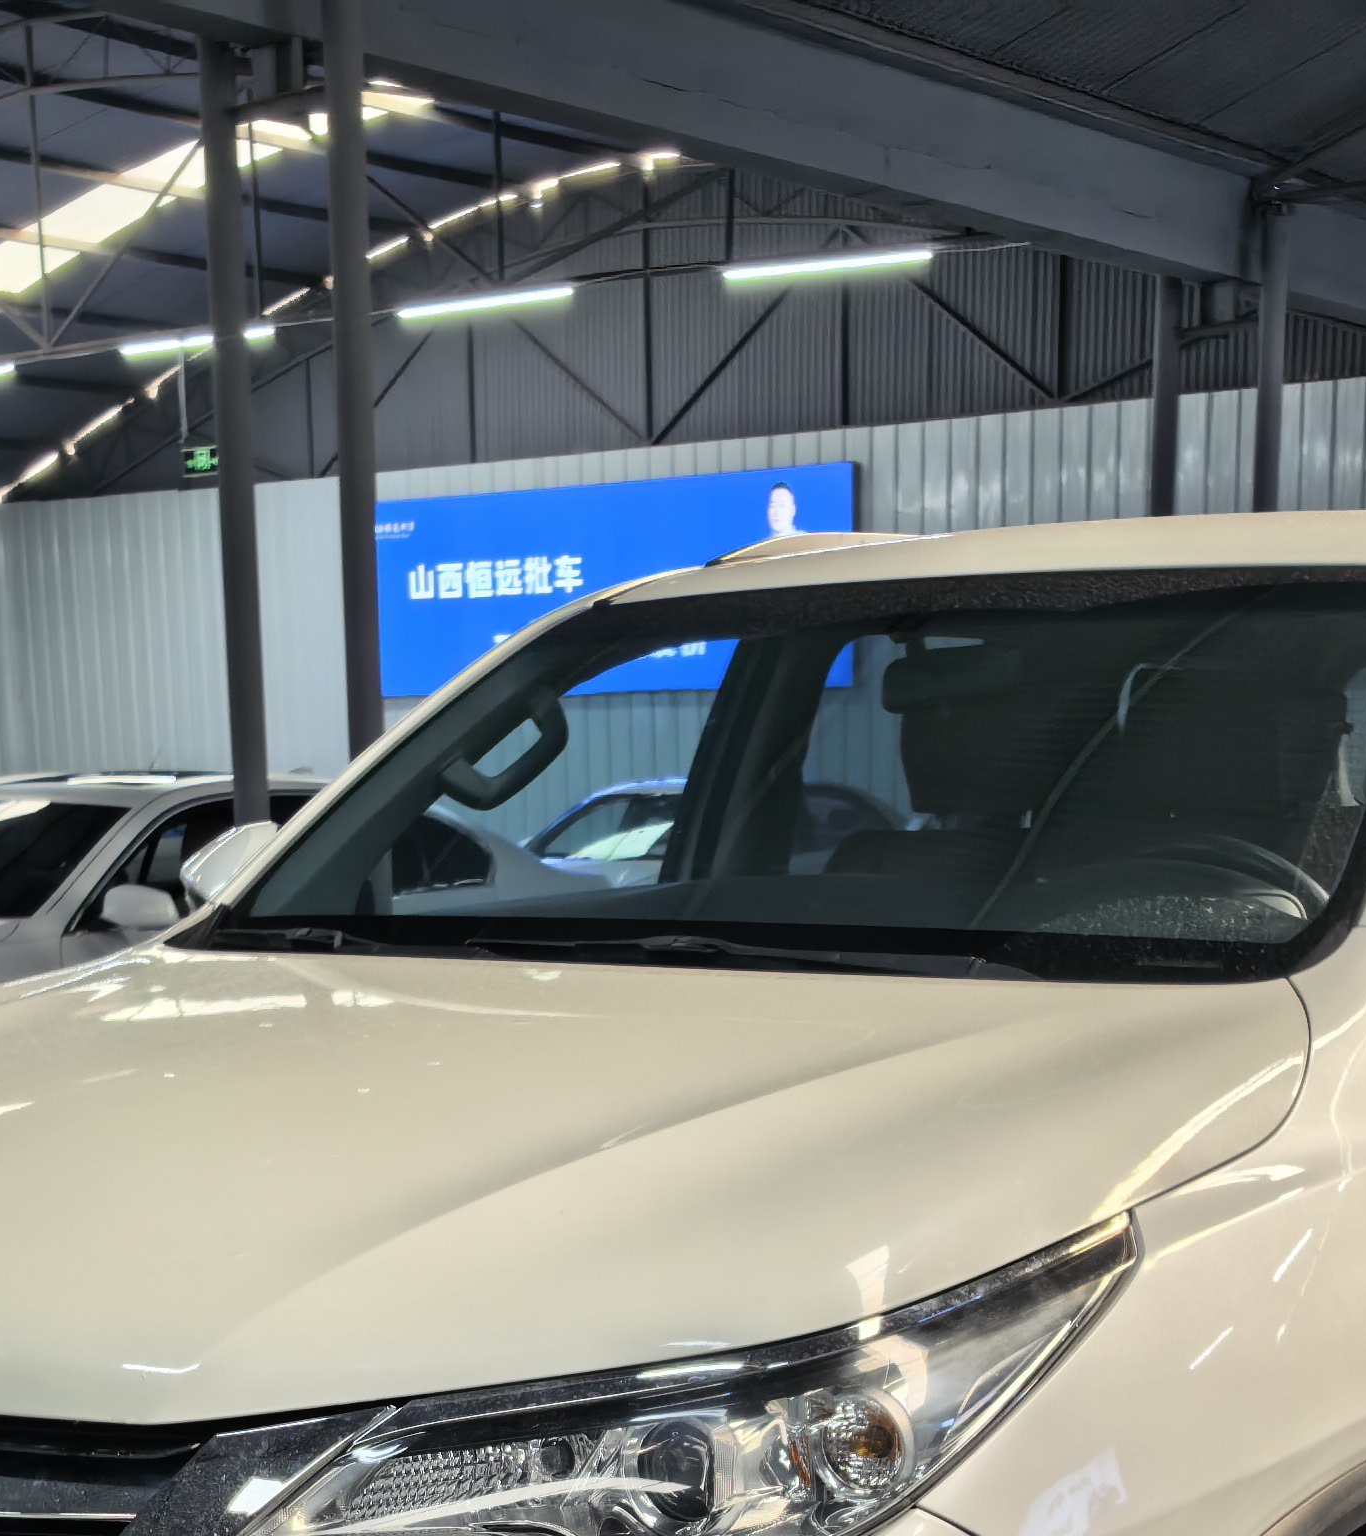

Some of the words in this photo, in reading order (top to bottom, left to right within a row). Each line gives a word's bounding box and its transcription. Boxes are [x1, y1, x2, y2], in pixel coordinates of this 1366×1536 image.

[408, 554, 584, 600] 山西恒远批车
